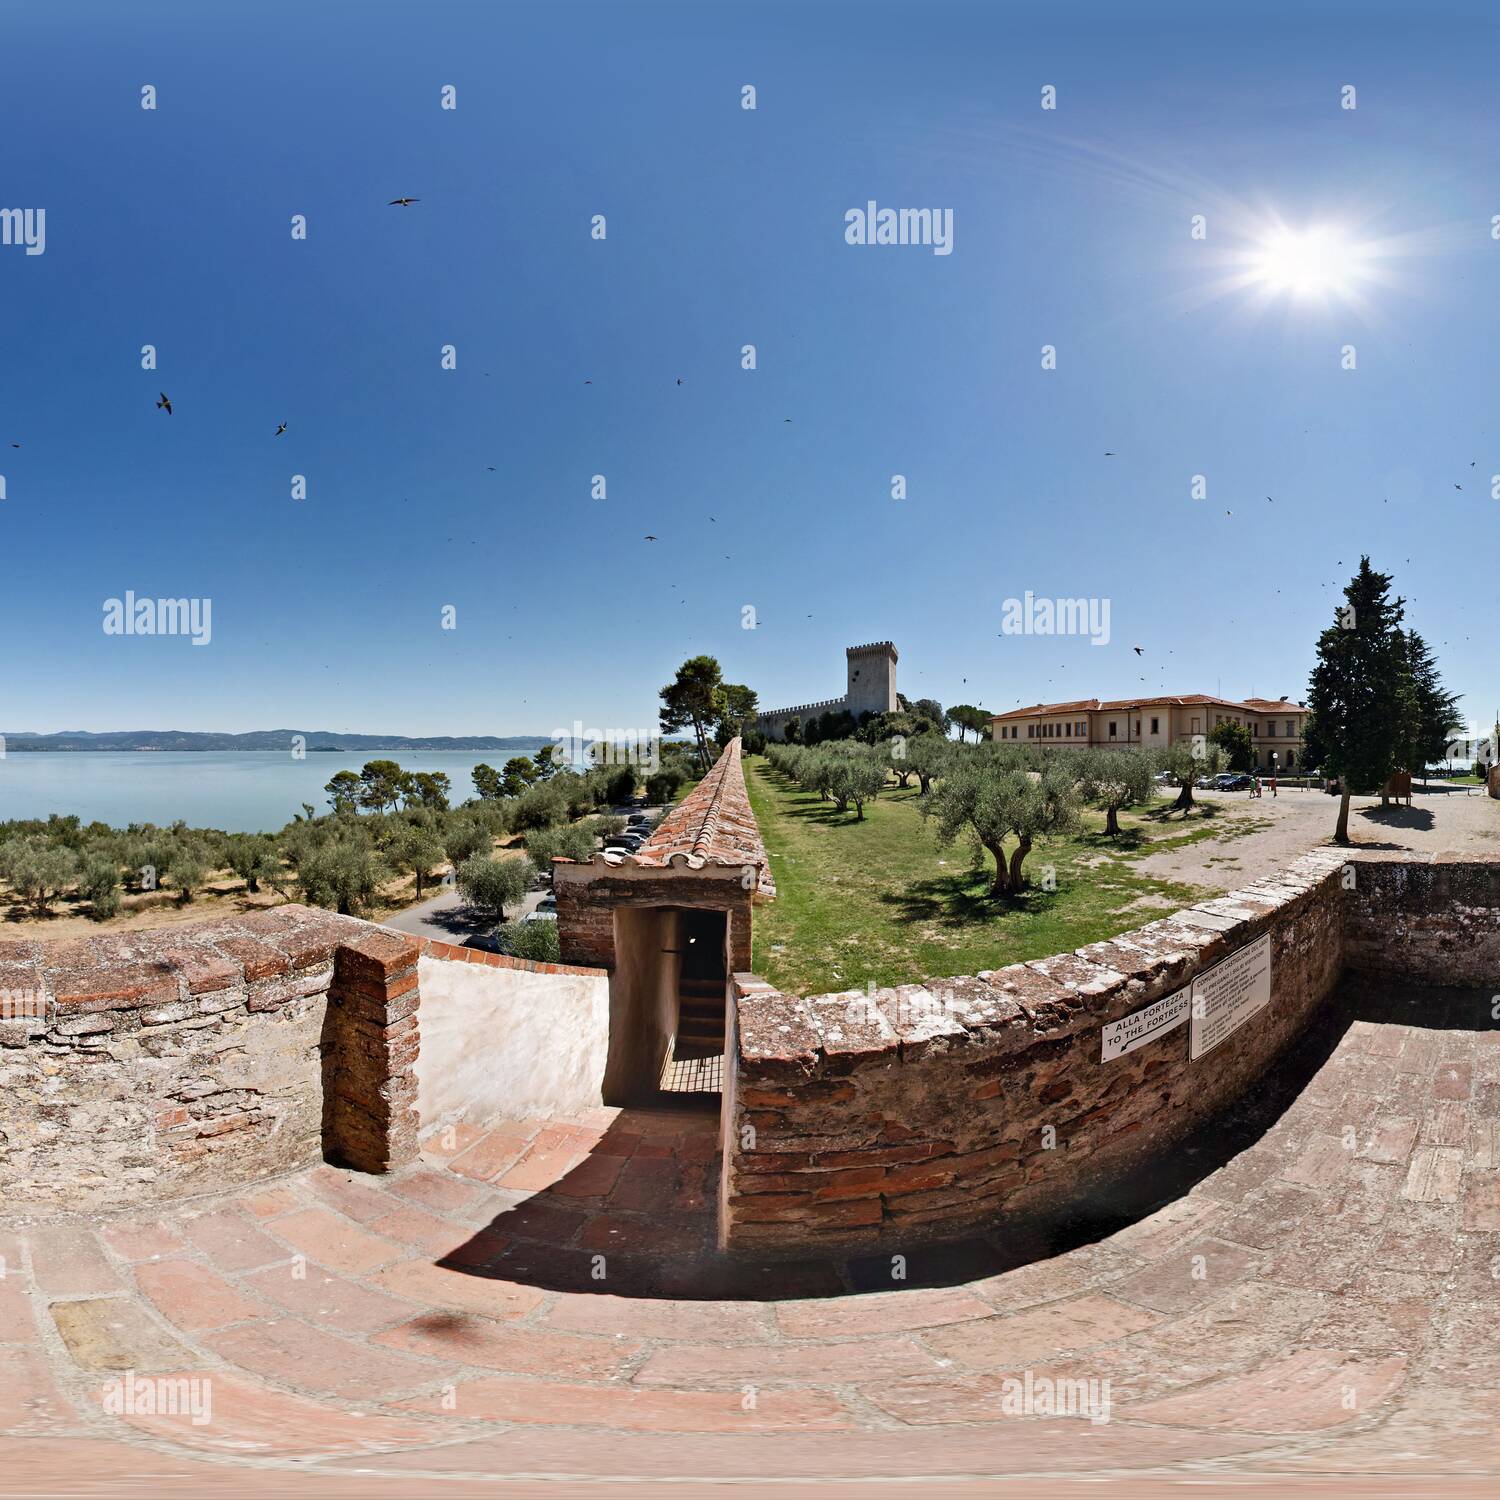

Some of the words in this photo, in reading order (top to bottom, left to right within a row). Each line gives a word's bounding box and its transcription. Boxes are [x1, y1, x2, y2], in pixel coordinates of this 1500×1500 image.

[1197, 971, 1218, 988] COMUNE
[1225, 950, 1250, 970] CASTIGLIONE
[1209, 973, 1229, 990] PREGANO
[1107, 1036, 1121, 1046] TO
[1125, 1025, 1143, 1039] THE
[1147, 1000, 1188, 1029] FORTRESS
[1116, 1015, 1139, 1032] ALLA
[1143, 992, 1184, 1019] FORTEZZA
